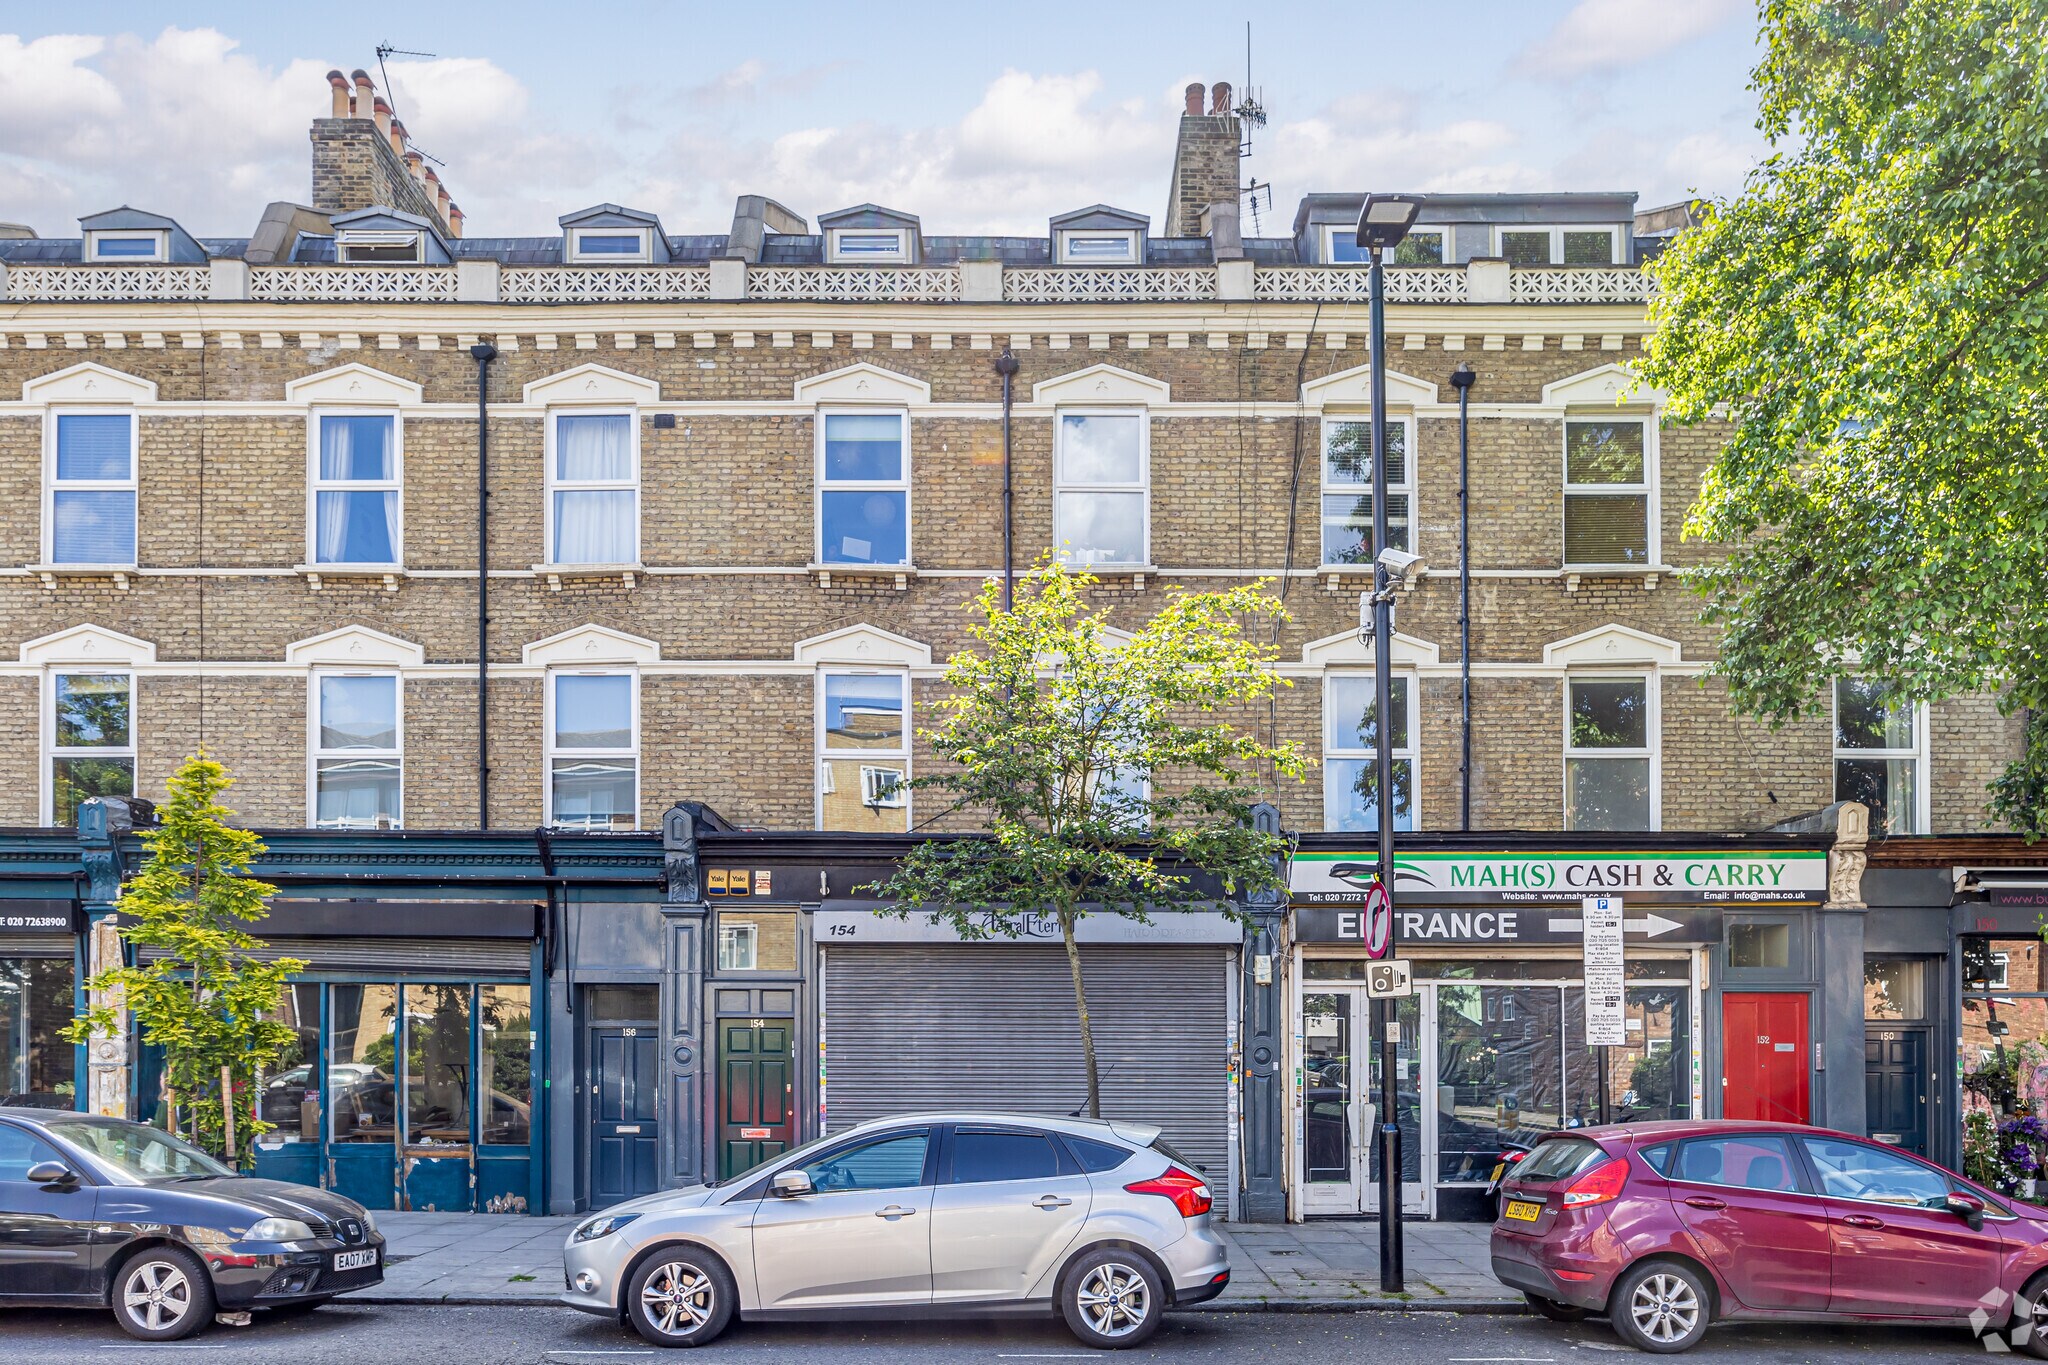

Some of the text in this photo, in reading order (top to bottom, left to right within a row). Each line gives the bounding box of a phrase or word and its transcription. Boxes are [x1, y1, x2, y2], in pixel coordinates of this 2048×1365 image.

[710, 875, 725, 883] Yale
[731, 875, 746, 883] Yale
[1451, 862, 1787, 889] MAH(S) CASH & CARRY
[1308, 893, 1323, 901] Tel:
[1325, 893, 1339, 901] 020
[1341, 893, 1362, 901] 7272
[1502, 892, 1538, 900] Website:
[1703, 891, 1806, 901] Email: info@mahs.co.uk
[7, 916, 24, 926] 020
[25, 916, 67, 927] 72638900
[1337, 912, 1518, 939] ERANCE
[1976, 917, 1998, 931] 150
[829, 924, 856, 936] 154
[750, 1020, 764, 1028] 154
[622, 1028, 637, 1036] 156
[1880, 1032, 1895, 1040] 150
[1757, 1035, 1770, 1044] 152
[338, 1253, 360, 1269] EA07
